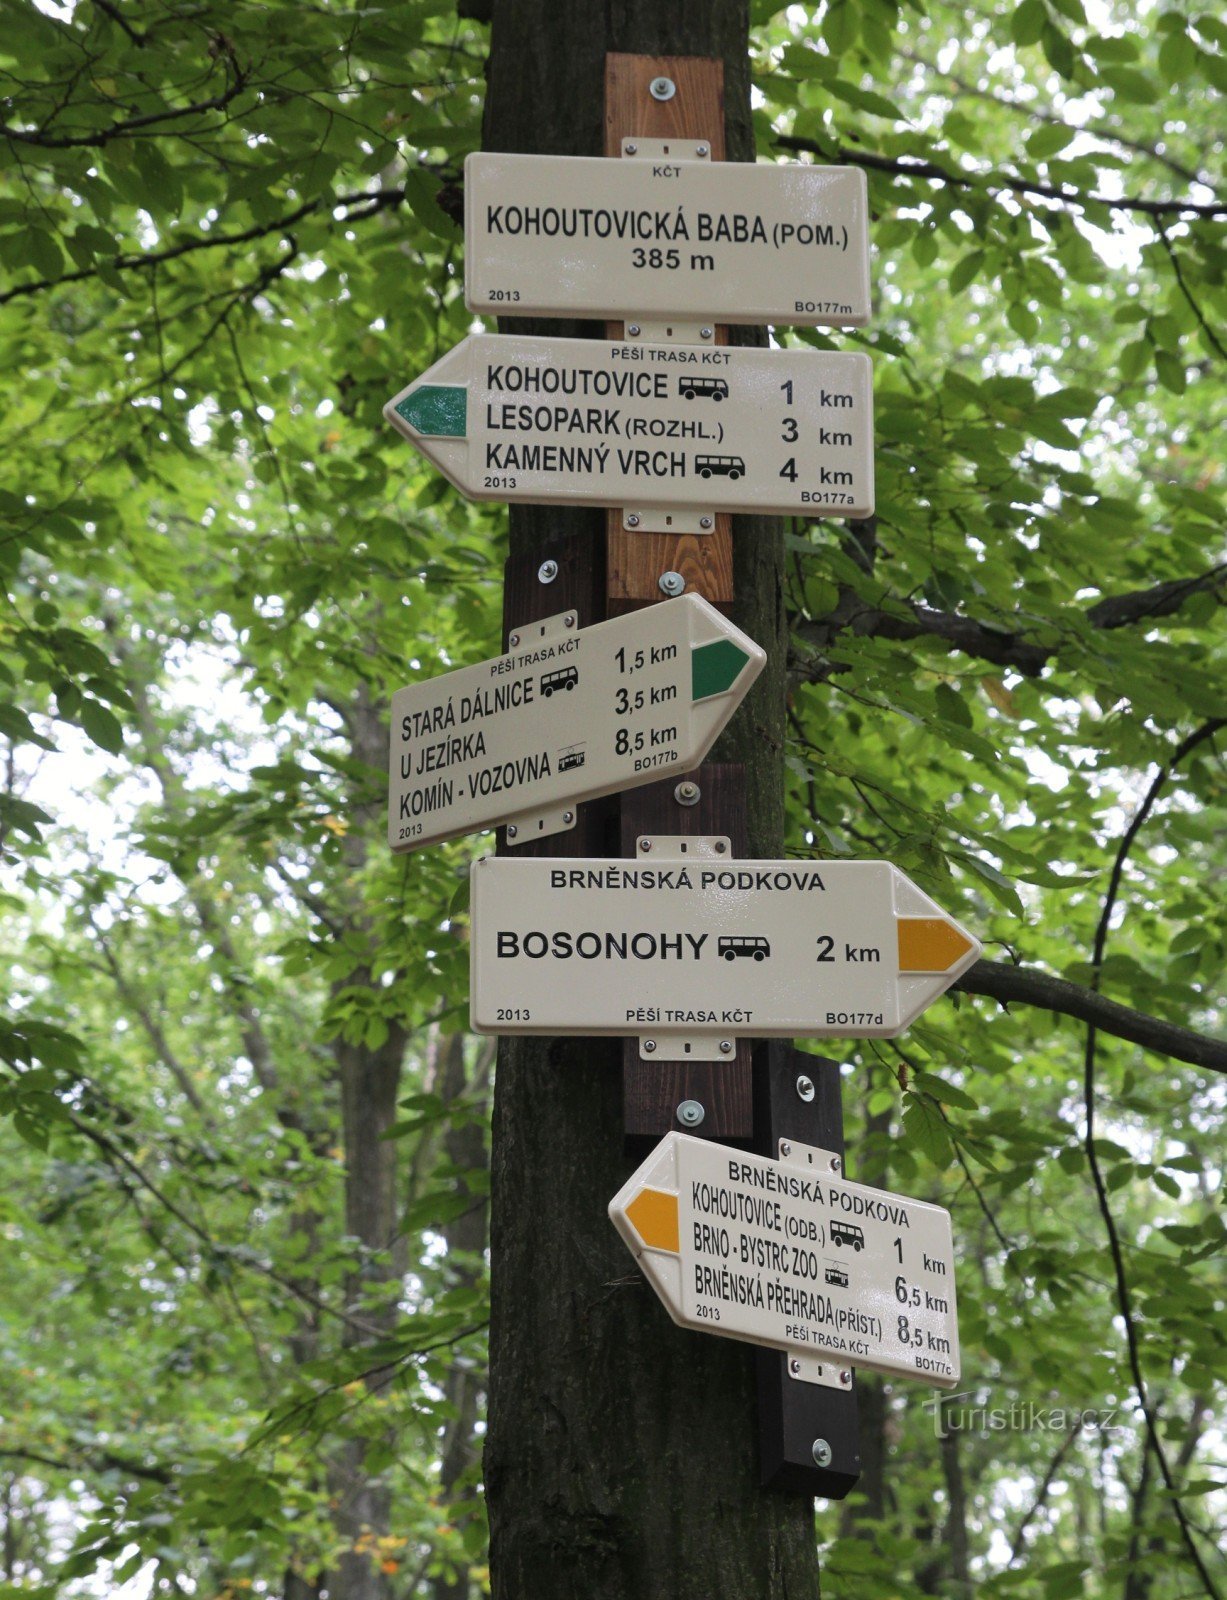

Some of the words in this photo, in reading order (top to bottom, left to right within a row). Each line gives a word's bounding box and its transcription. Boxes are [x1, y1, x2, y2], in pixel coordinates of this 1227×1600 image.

[653, 166, 681, 177] KČT
[487, 206, 689, 239] KOHOUTOVICKÁ
[698, 215, 767, 243] BABA
[773, 223, 848, 250] (POM.)
[632, 249, 680, 269] 385
[691, 254, 714, 270] m
[489, 291, 520, 301] 2013
[795, 302, 852, 314] BO177m
[612, 348, 645, 360] PĚŠÍ
[649, 351, 697, 362] TRASA
[702, 353, 731, 364] KČT
[487, 365, 668, 398] KOHOUTOVICE
[781, 380, 793, 404] 1
[820, 391, 853, 408] km
[487, 405, 620, 434] LESOPARK
[625, 418, 724, 443] (ROZHL.)
[782, 419, 799, 443] 3
[820, 428, 852, 446] km
[486, 443, 610, 474] KAMENNÝ
[618, 450, 685, 476] VRCH
[779, 459, 798, 483] 4
[820, 468, 853, 485] km
[485, 477, 516, 488] 2013
[801, 492, 854, 504] BO177a
[491, 661, 515, 676] PĚŠÍ
[518, 650, 556, 669] TRASA
[558, 639, 580, 658] KČT
[402, 703, 455, 741] STARÁ
[461, 678, 533, 723] DÁLNICE
[615, 647, 644, 674] 1,5
[651, 644, 676, 662] km
[401, 755, 410, 779] U
[417, 732, 486, 774] JEZÍRKA
[615, 688, 644, 715] 3,5
[651, 684, 676, 703] km
[400, 781, 452, 819] KOMÍN
[469, 752, 550, 799] VOZOVNA
[615, 729, 644, 756] 8,5
[651, 726, 676, 745] km
[635, 751, 678, 771] BO177b
[400, 823, 422, 839] 2013
[551, 867, 692, 889] BRNĚNSKÁ
[701, 872, 825, 891] PODKOVA
[497, 932, 708, 960] BOSONOHY
[817, 936, 835, 962] 2
[846, 943, 880, 961] km
[496, 1009, 530, 1020] 2013
[626, 1008, 661, 1021] PĚŠÍ
[665, 1010, 717, 1022] TRASA
[722, 1008, 752, 1022] KČT
[826, 1013, 883, 1024] BO177d
[729, 1161, 824, 1205] BRNĚNSKÁ
[830, 1189, 909, 1228] PODKOVA
[692, 1182, 781, 1230] KOHOUTOVICE
[785, 1215, 825, 1248] (ODB.)
[894, 1238, 903, 1264] 1
[924, 1254, 946, 1275] km
[694, 1222, 729, 1257] BRNO
[741, 1234, 788, 1273] BYSTRC
[793, 1248, 817, 1280] ZOO
[895, 1276, 921, 1307] 6,5
[925, 1291, 947, 1313] km
[695, 1265, 764, 1307] BRNĚNSKÁ
[768, 1278, 835, 1324] PŘEHRADA
[836, 1306, 882, 1342] (PŘÍST.)
[897, 1316, 923, 1347] 8,5
[928, 1331, 950, 1353] km
[696, 1305, 720, 1320] 2013
[786, 1325, 809, 1341] PĚŠÍ
[812, 1331, 847, 1350] TRASA
[849, 1338, 869, 1355] KČT
[915, 1357, 952, 1375] BO177c
